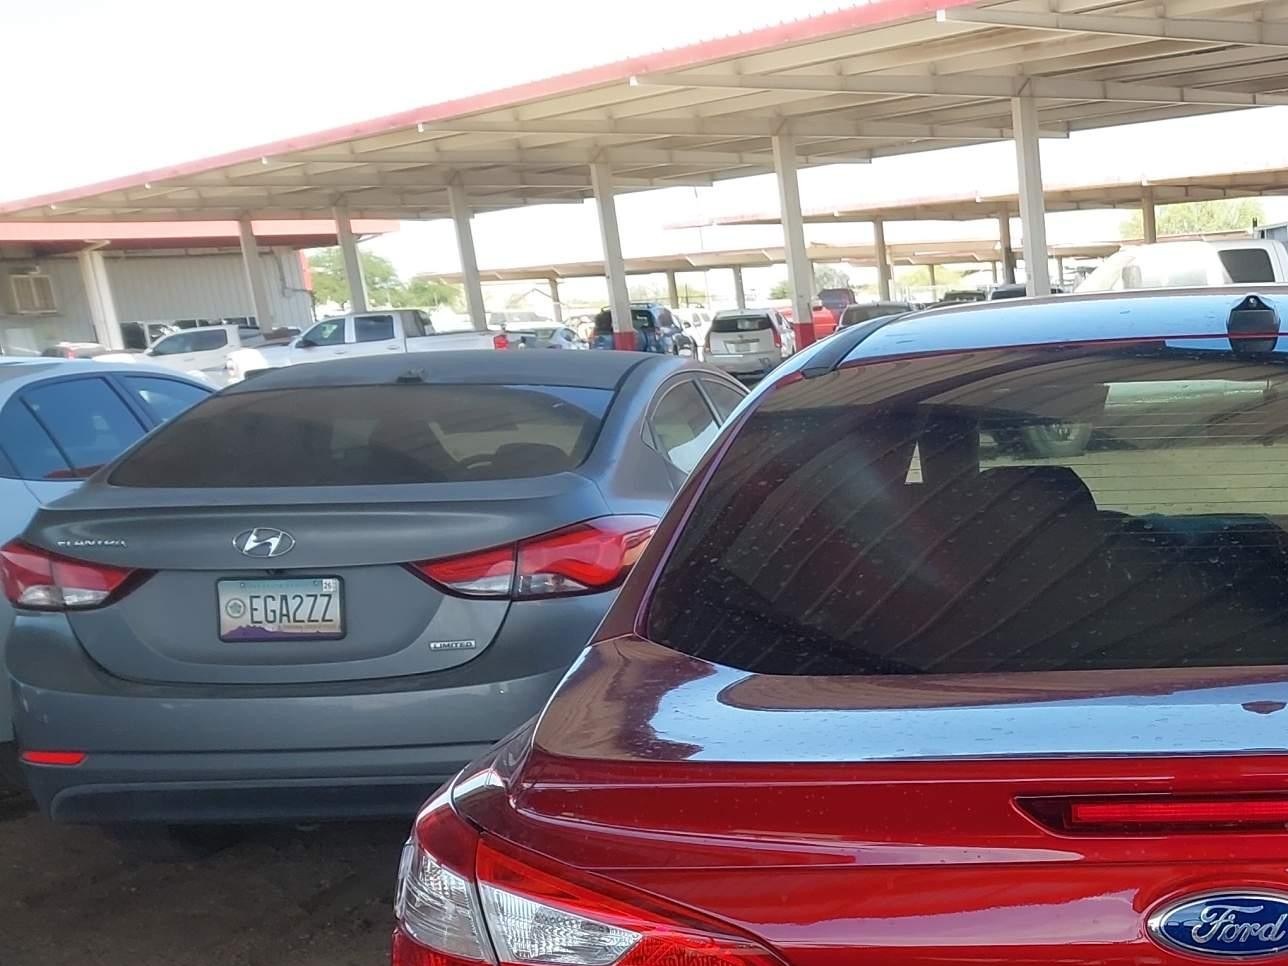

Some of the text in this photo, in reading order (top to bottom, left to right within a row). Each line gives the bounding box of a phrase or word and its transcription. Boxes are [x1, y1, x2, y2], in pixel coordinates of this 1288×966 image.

[249, 594, 334, 624] EGA2ZZ
[433, 641, 473, 649] LIMITED
[1191, 904, 1288, 944] Ford
